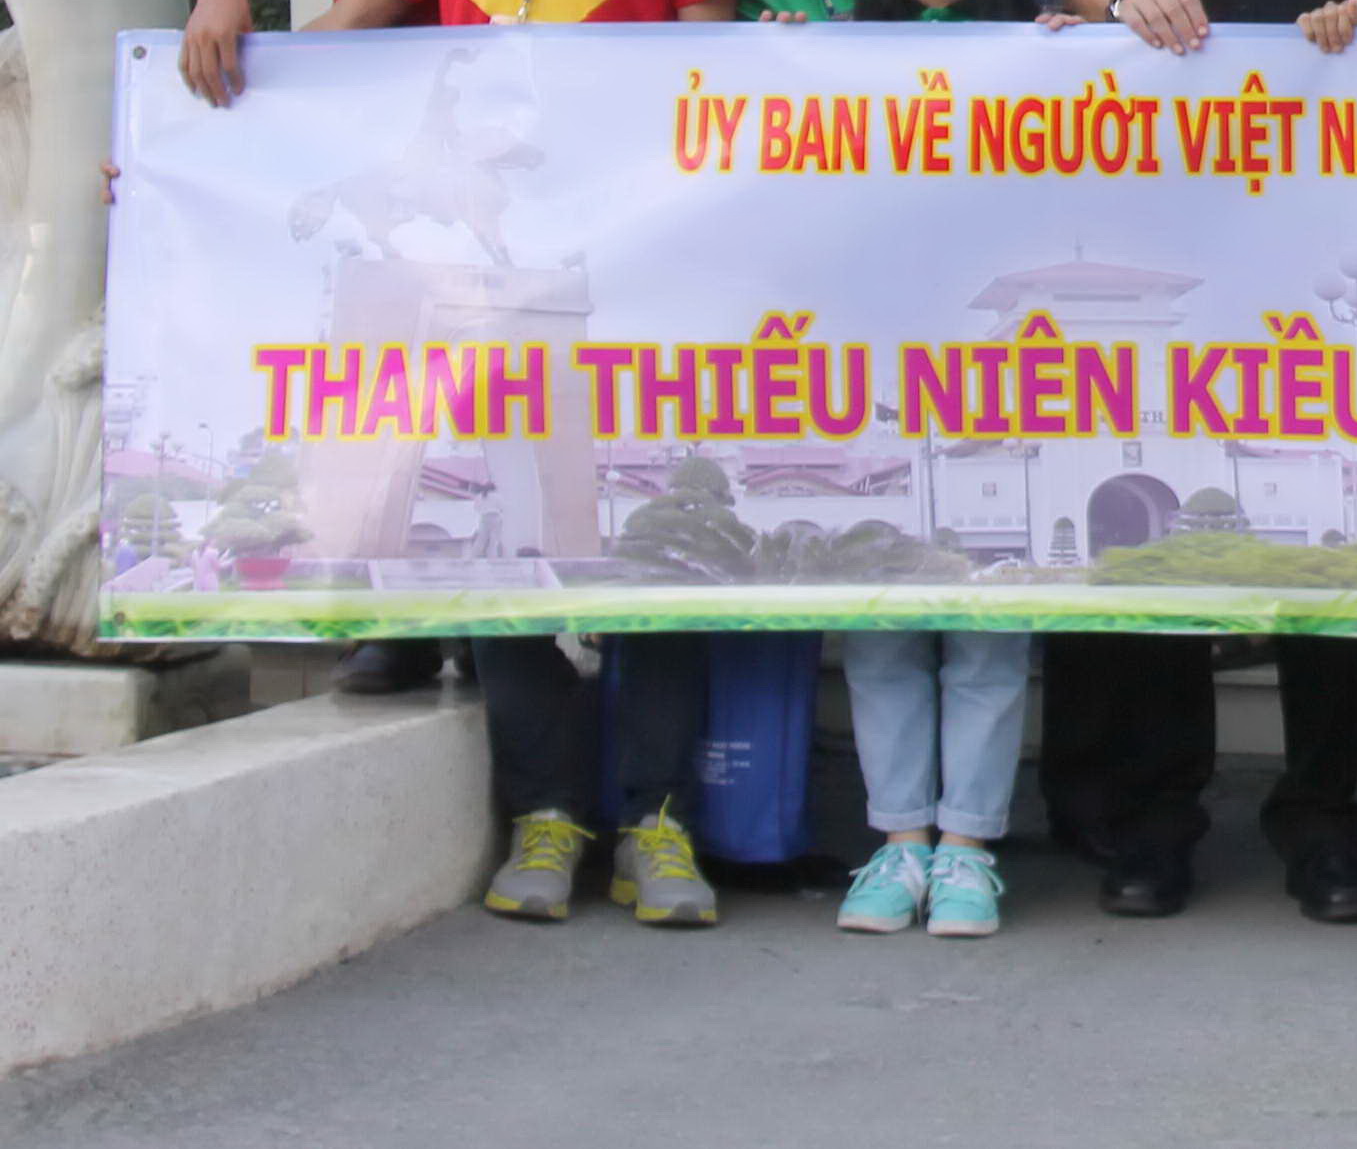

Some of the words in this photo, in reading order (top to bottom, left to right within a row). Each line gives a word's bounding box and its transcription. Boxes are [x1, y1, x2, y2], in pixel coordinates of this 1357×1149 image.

[675, 71, 747, 173] ỦY
[760, 95, 870, 172] BAN
[884, 70, 954, 174] VỀ
[970, 72, 1162, 176] NGƯỜI
[1175, 74, 1306, 194] VIỆT
[257, 346, 547, 437] THANH
[576, 314, 867, 436] THIẾU
[903, 312, 1135, 435] NIÊN
